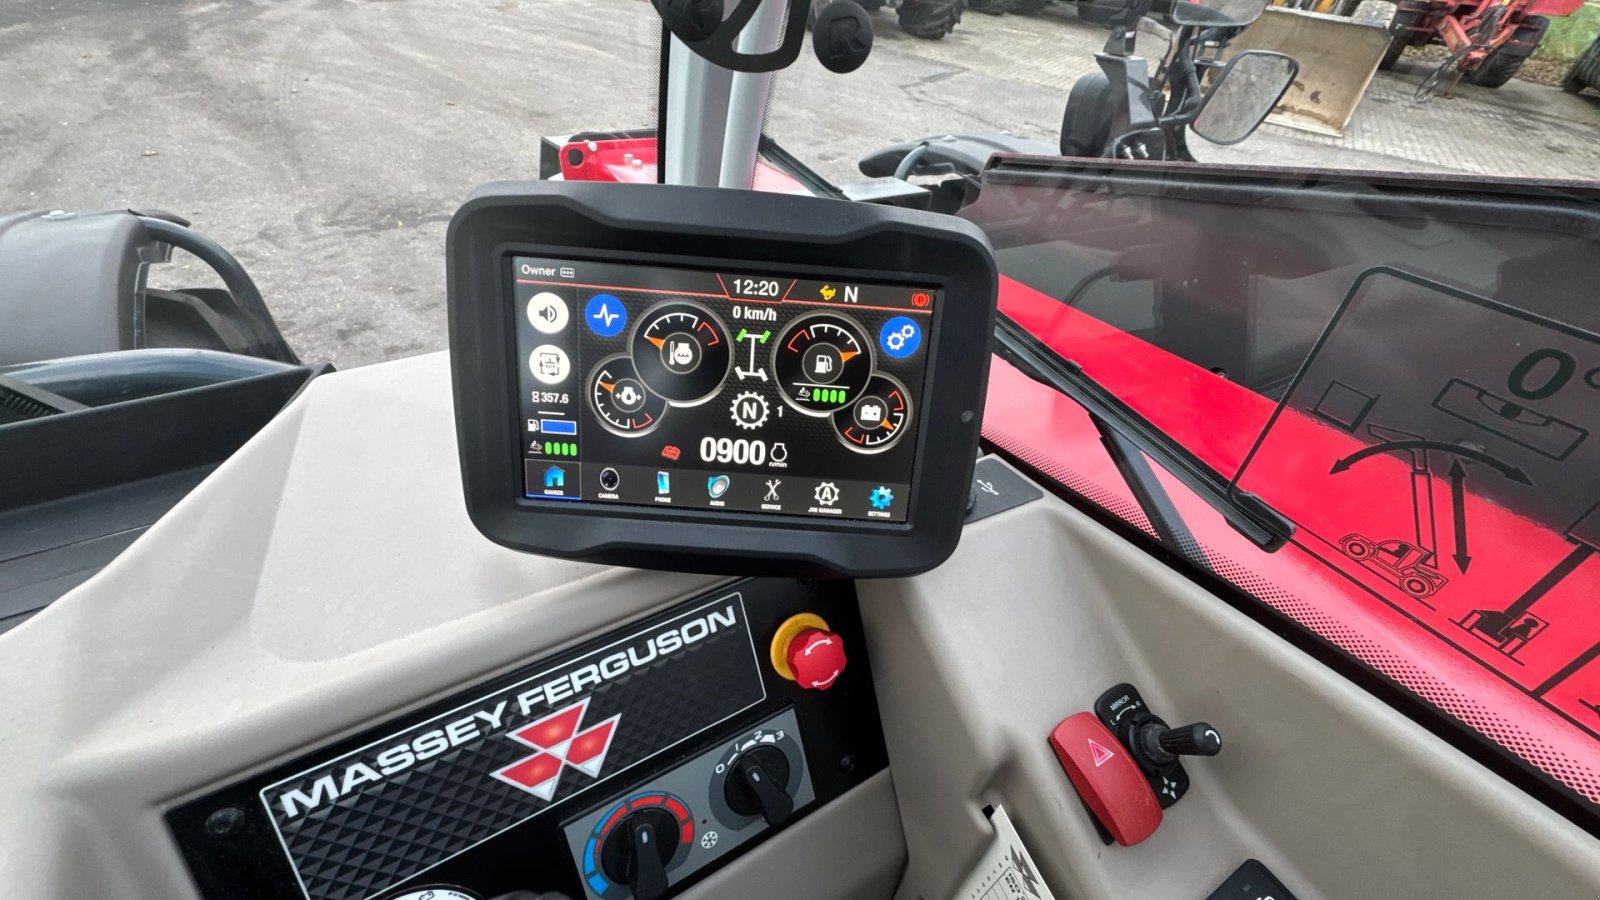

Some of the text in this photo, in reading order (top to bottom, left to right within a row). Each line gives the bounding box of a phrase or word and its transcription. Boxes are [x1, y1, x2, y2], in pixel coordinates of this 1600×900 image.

[521, 264, 556, 276] Owner
[733, 278, 779, 297] 12:20
[844, 285, 859, 303] N
[732, 305, 777, 322] 0 km/h
[541, 392, 569, 404] 357.6
[742, 401, 757, 420] N
[776, 405, 784, 418] 1
[700, 436, 766, 466] 0900
[821, 486, 832, 500] A
[761, 503, 782, 511] SERVICE
[818, 507, 842, 515] MANAGER
[867, 510, 891, 518] SETTINGS
[1110, 694, 1130, 711] MIRROR
[1135, 700, 1142, 708] R
[279, 604, 737, 818] MASSEY FERGUSON
[754, 730, 763, 740] 2
[775, 730, 785, 740] 3
[715, 763, 725, 774] 0
